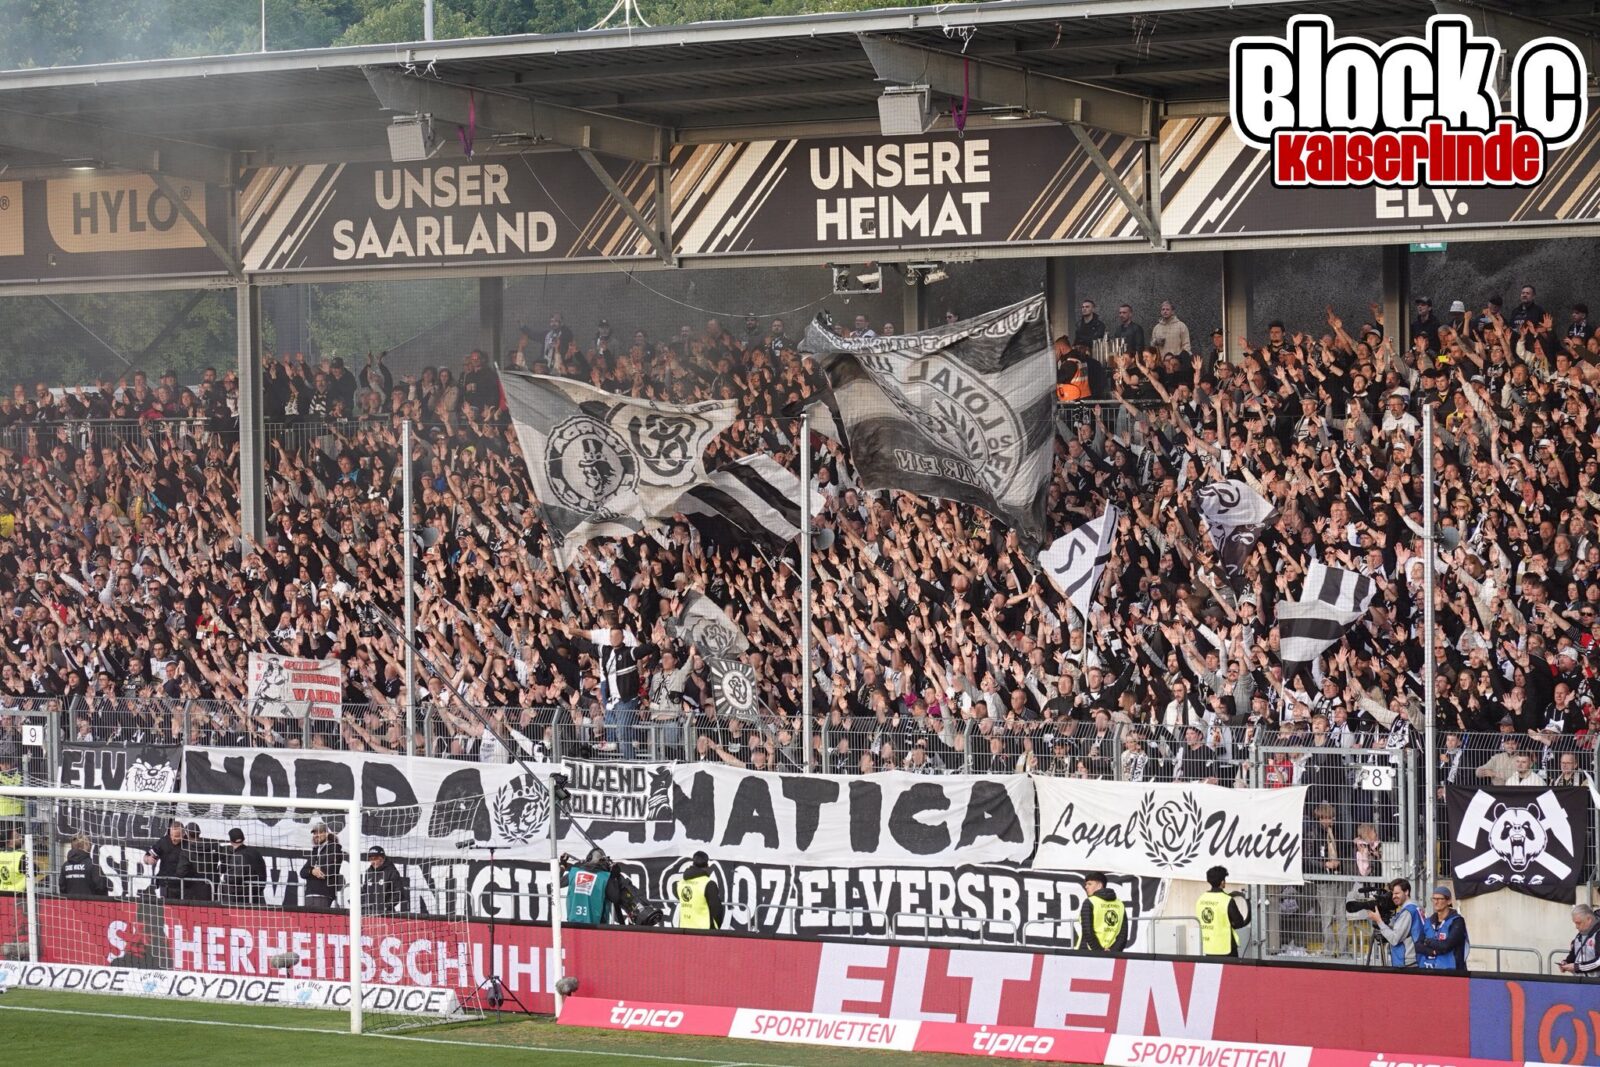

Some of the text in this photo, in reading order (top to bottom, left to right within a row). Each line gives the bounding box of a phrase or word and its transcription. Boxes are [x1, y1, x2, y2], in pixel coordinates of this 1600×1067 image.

[810, 139, 990, 190] UNSERE
[375, 164, 511, 210] UNSER
[73, 188, 179, 235] HYLO
[816, 191, 990, 241] HEIMAT
[1376, 188, 1469, 223] ELV.
[332, 211, 557, 261] SAARLAND
[29, 727, 37, 743] 9
[60, 750, 127, 790] ELV
[562, 763, 645, 793] JUGEND
[1372, 768, 1382, 787] 8
[1041, 802, 1139, 858] Loyal
[1203, 810, 1301, 872] Unity
[18, 965, 129, 992] ICYDICE
[168, 975, 285, 1003] ICYDICE
[812, 942, 1224, 1040] ELTEN
[610, 1000, 684, 1028] tipico
[752, 1015, 897, 1044] SPORTWETTEN
[973, 1025, 1054, 1055] tipico
[1128, 1041, 1286, 1067] SPORTWETTEN
